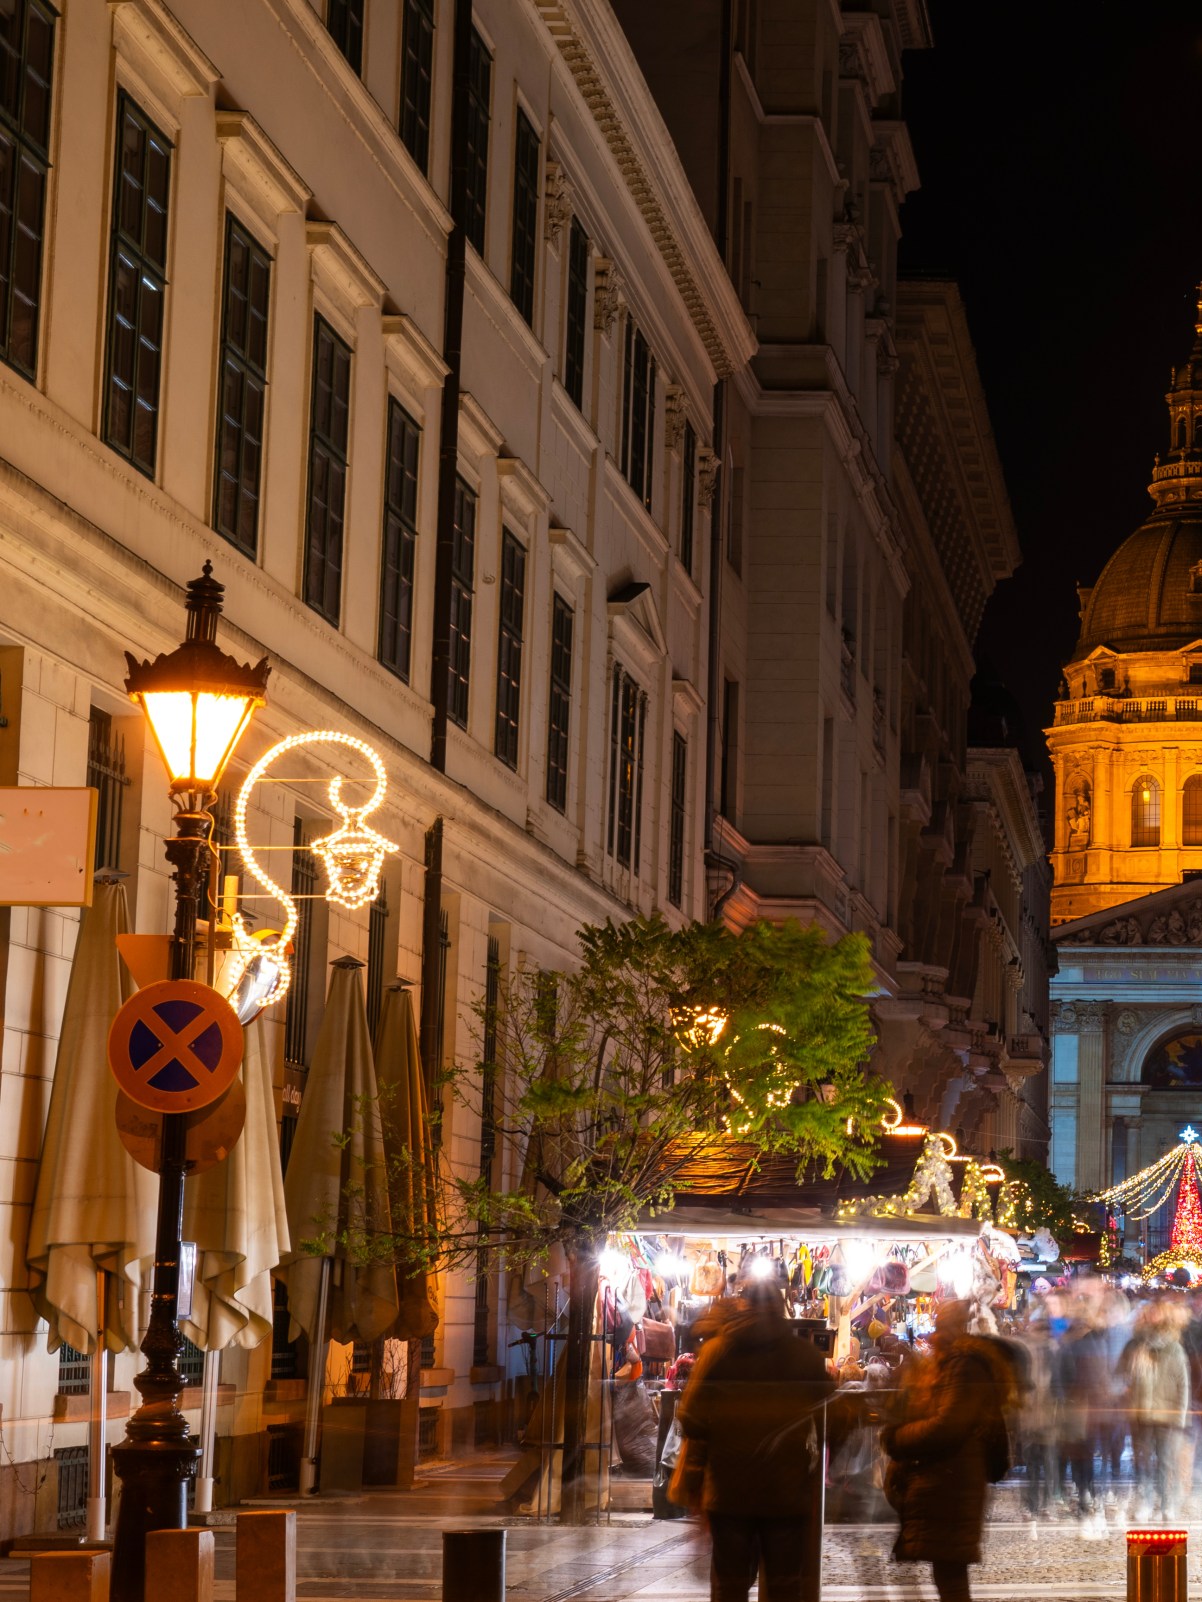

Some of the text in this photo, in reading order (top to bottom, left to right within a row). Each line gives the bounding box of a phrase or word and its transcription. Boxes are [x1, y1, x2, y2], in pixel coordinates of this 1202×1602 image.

[1096, 970, 1122, 980] EGO
[1130, 969, 1157, 980] SUM
[1167, 970, 1187, 979] VIA
